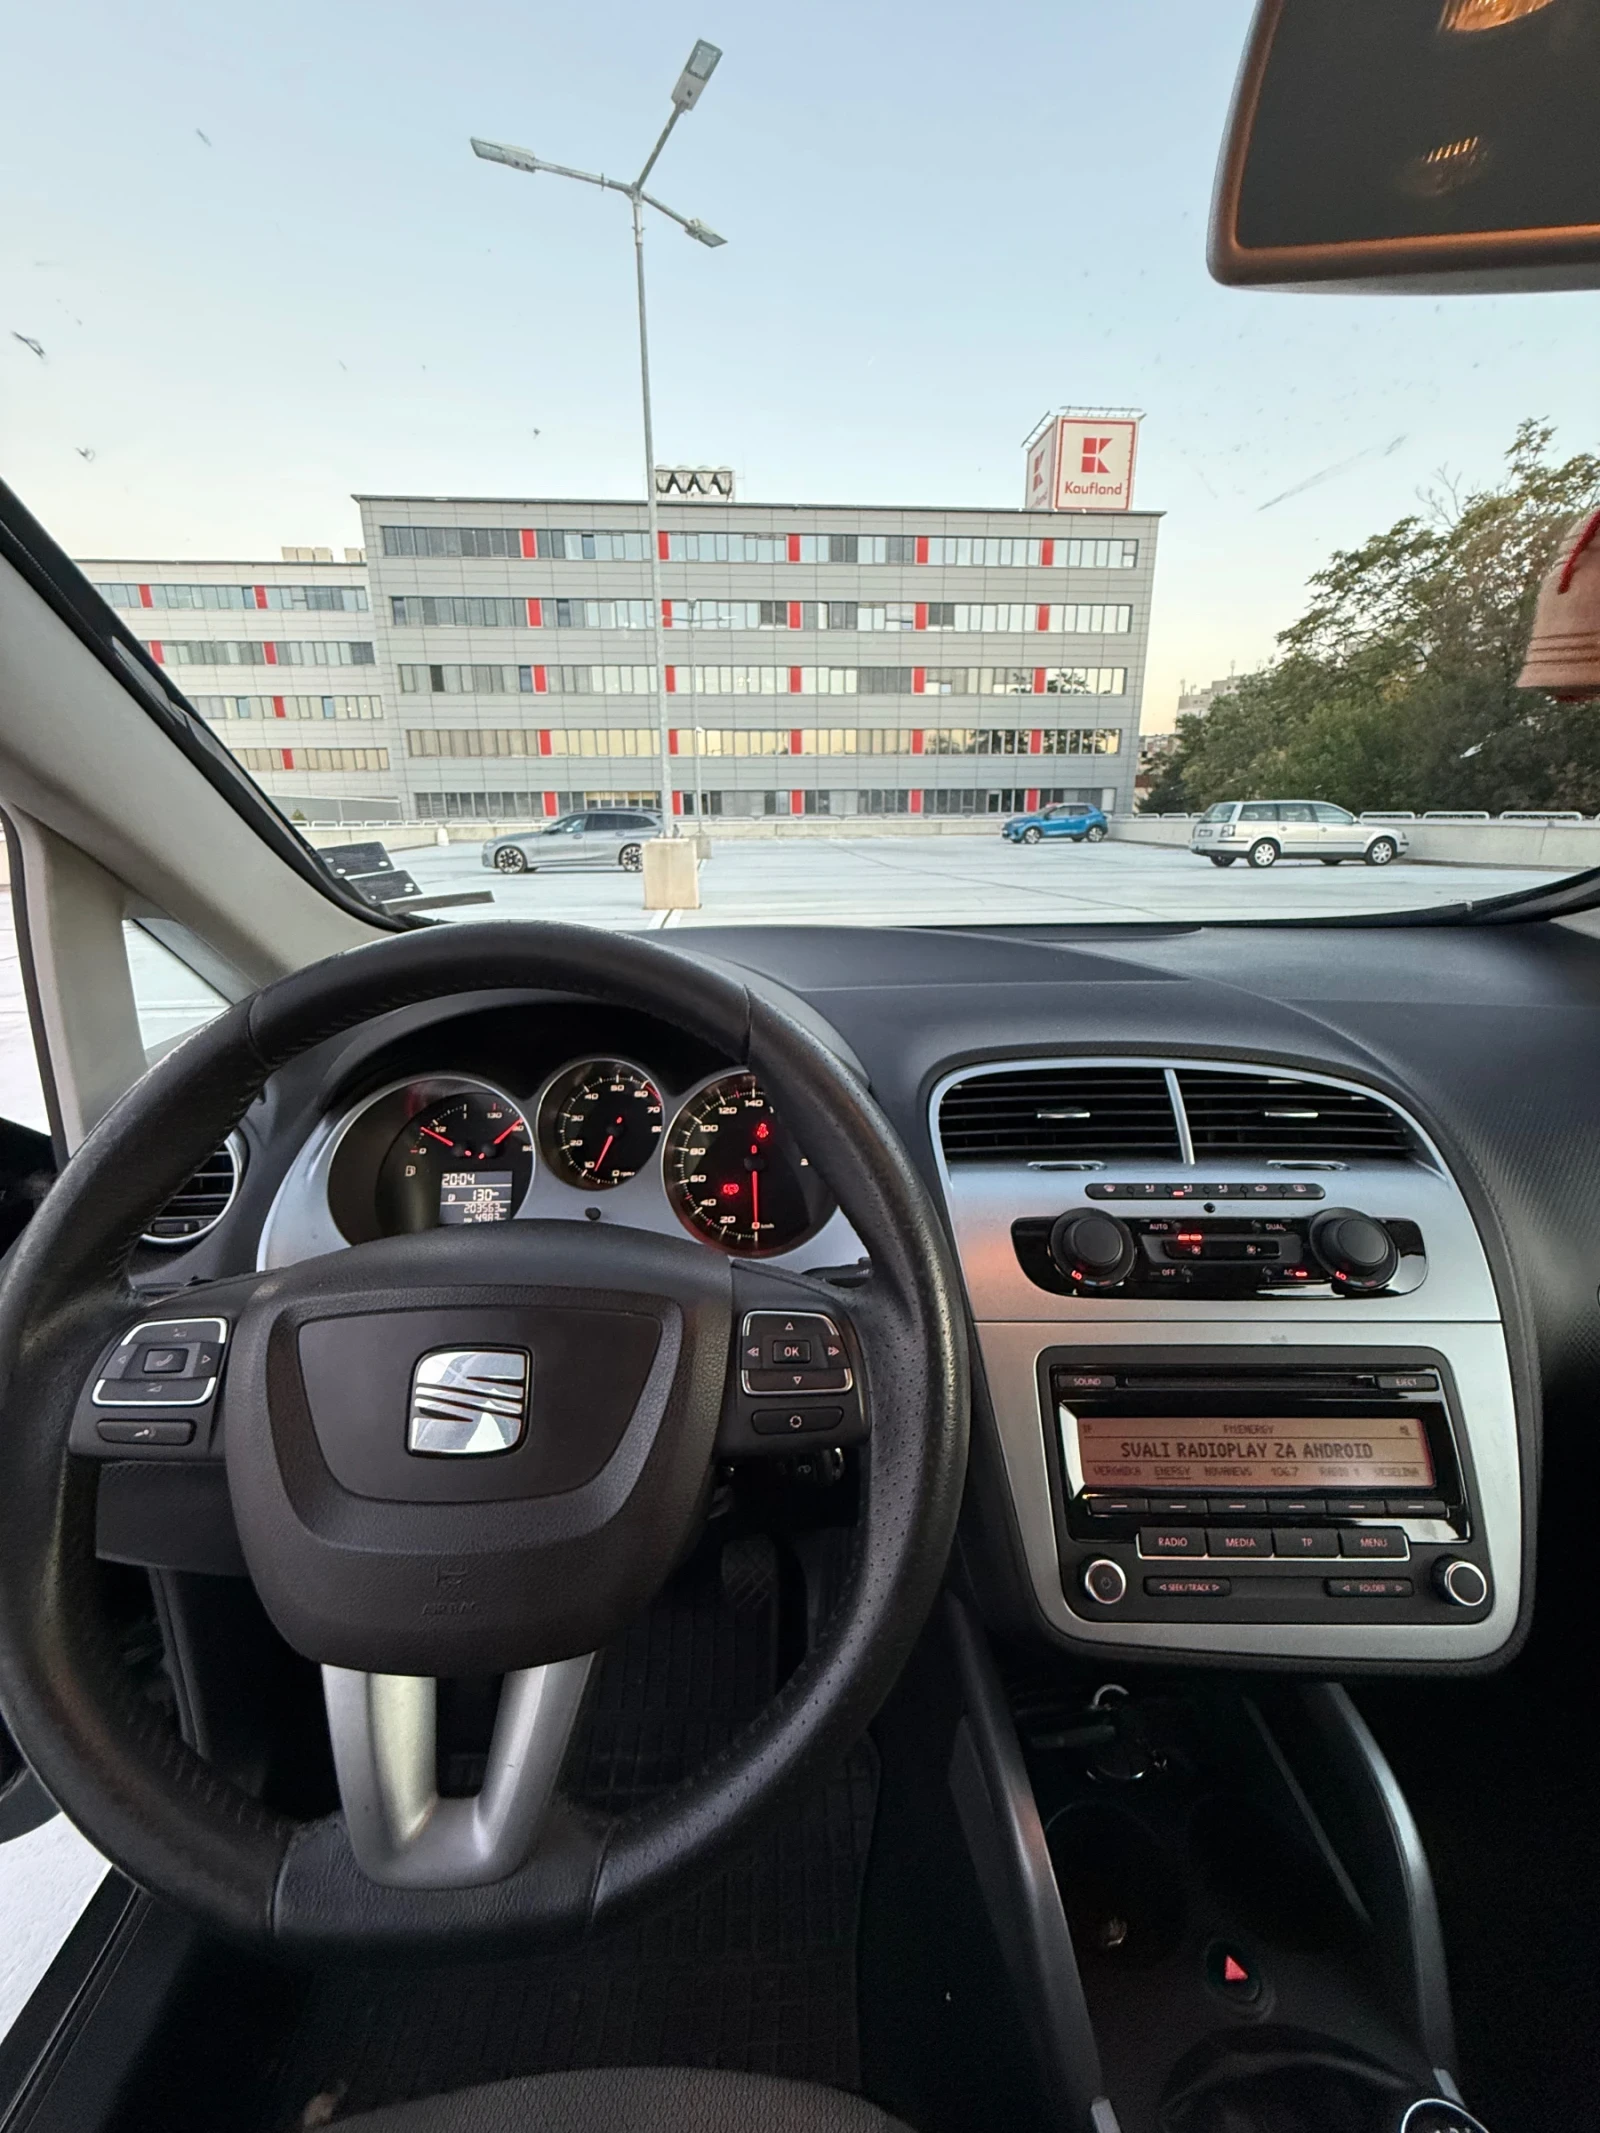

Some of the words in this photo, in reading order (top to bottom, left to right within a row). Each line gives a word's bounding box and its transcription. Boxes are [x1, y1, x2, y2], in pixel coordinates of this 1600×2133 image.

[1064, 481, 1122, 495] Kaufland
[442, 1173, 475, 1186] 20:04
[472, 1189, 493, 1201] 130
[463, 1203, 500, 1214] 203563
[720, 1216, 736, 1224] 20
[1071, 1270, 1082, 1280] LO
[1335, 1270, 1347, 1280] LO
[784, 1346, 799, 1357] OK
[1073, 1378, 1101, 1386] SOUND
[1176, 1442, 1267, 1459] RADIOPLAY
[1274, 1443, 1297, 1458] ZA
[1303, 1443, 1374, 1459] ANDROID
[1155, 1466, 1191, 1476] ENERGY
[1158, 1538, 1188, 1547] RADIO
[1225, 1538, 1256, 1548] MEDIA
[1301, 1538, 1313, 1547] TP
[1360, 1538, 1388, 1547] MENU
[1359, 1584, 1386, 1592] FOLDER
